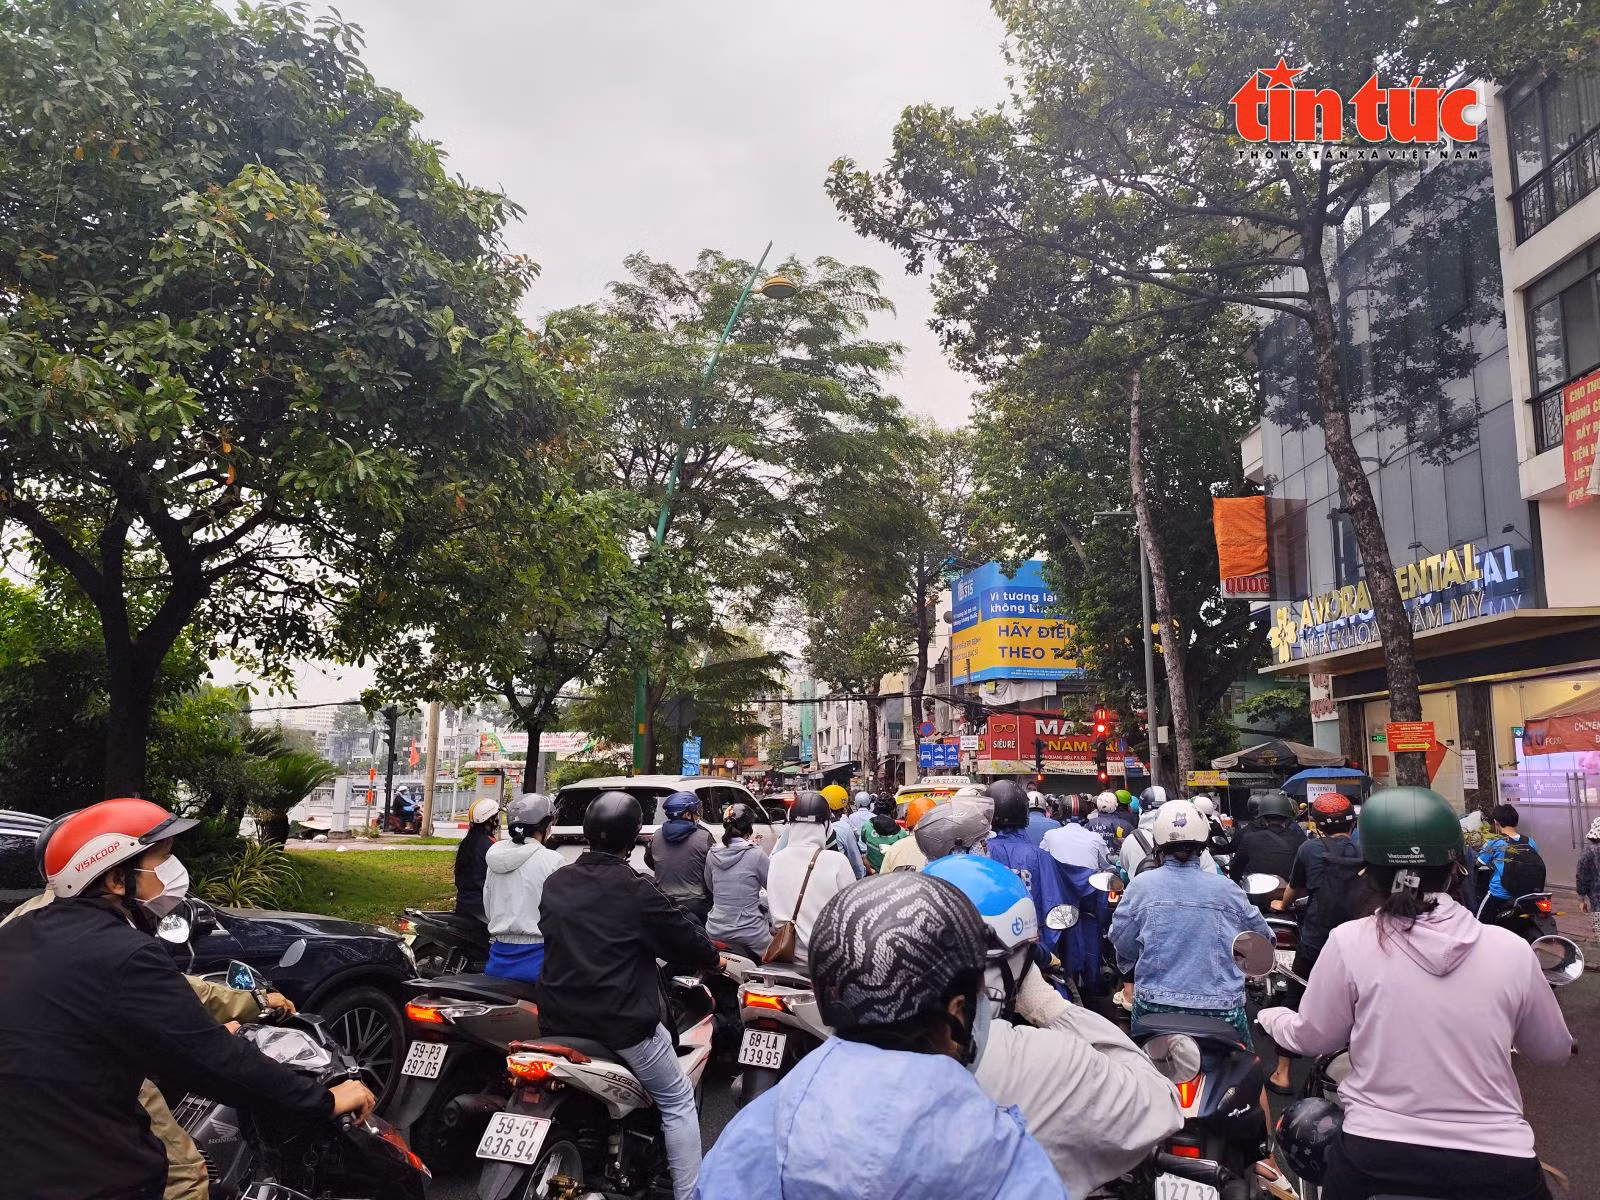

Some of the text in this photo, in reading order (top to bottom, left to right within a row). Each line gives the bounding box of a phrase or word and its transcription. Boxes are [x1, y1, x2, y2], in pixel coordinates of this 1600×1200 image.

[1300, 543, 1483, 628] AVORA ENTAL
[1003, 592, 1039, 603] tương
[990, 604, 1025, 613] không
[998, 622, 1033, 638] HÃY
[998, 646, 1045, 659] THEO
[1048, 740, 1088, 752] NAM
[75, 842, 120, 872] VISACOOP
[749, 1033, 778, 1050] 68-LA
[412, 1043, 441, 1060] 59-P3
[743, 1047, 780, 1066] 139.95
[404, 1059, 438, 1077] 397.05
[496, 1117, 539, 1138] 59-G1
[482, 1136, 535, 1161] 936.94
